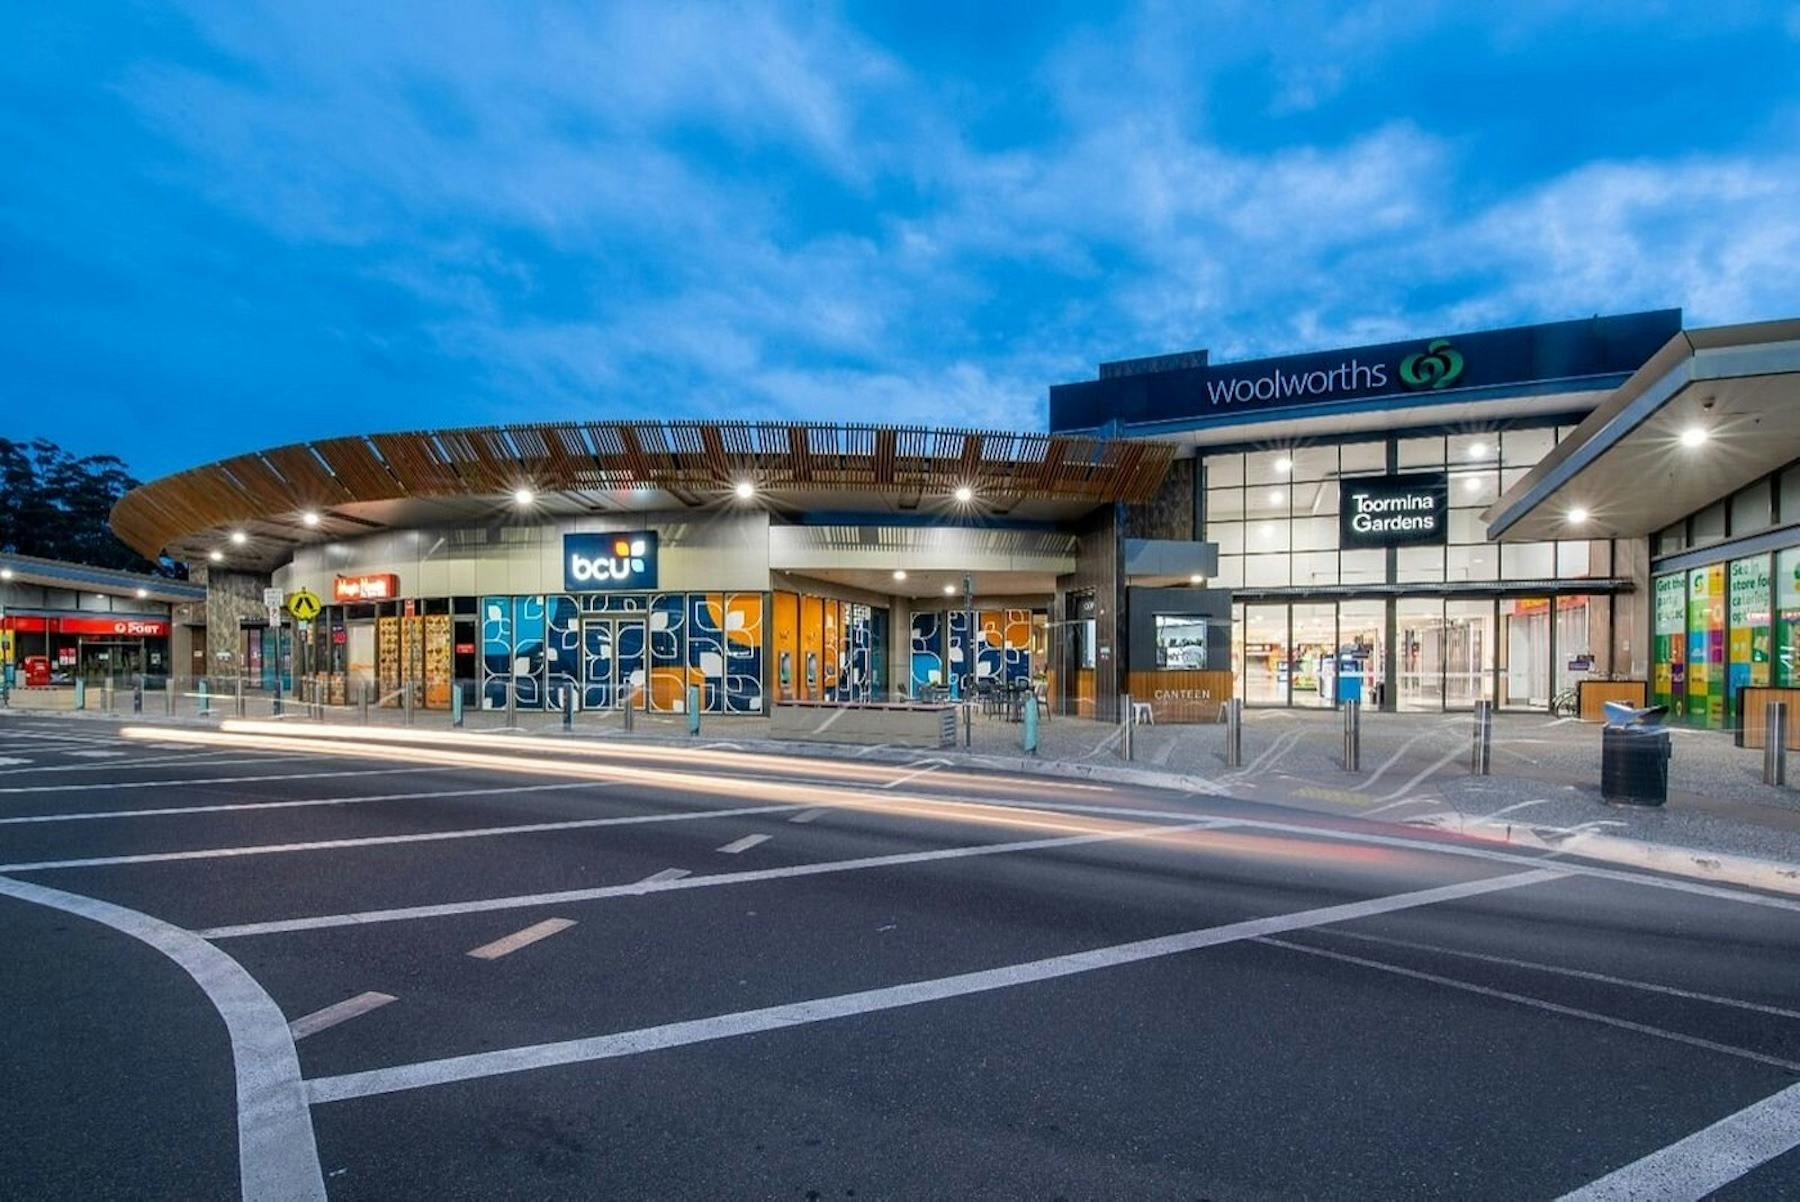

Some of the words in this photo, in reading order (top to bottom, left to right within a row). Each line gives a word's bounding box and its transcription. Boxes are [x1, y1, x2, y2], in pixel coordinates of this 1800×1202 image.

[1207, 359, 1387, 405] Woolworths
[1352, 494, 1434, 513] Toormina
[1352, 513, 1434, 533] Gardens
[572, 554, 631, 580] bcu
[1656, 580, 1671, 591] Get
[1732, 578, 1756, 591] store
[1154, 688, 1211, 700] CANTEEN
